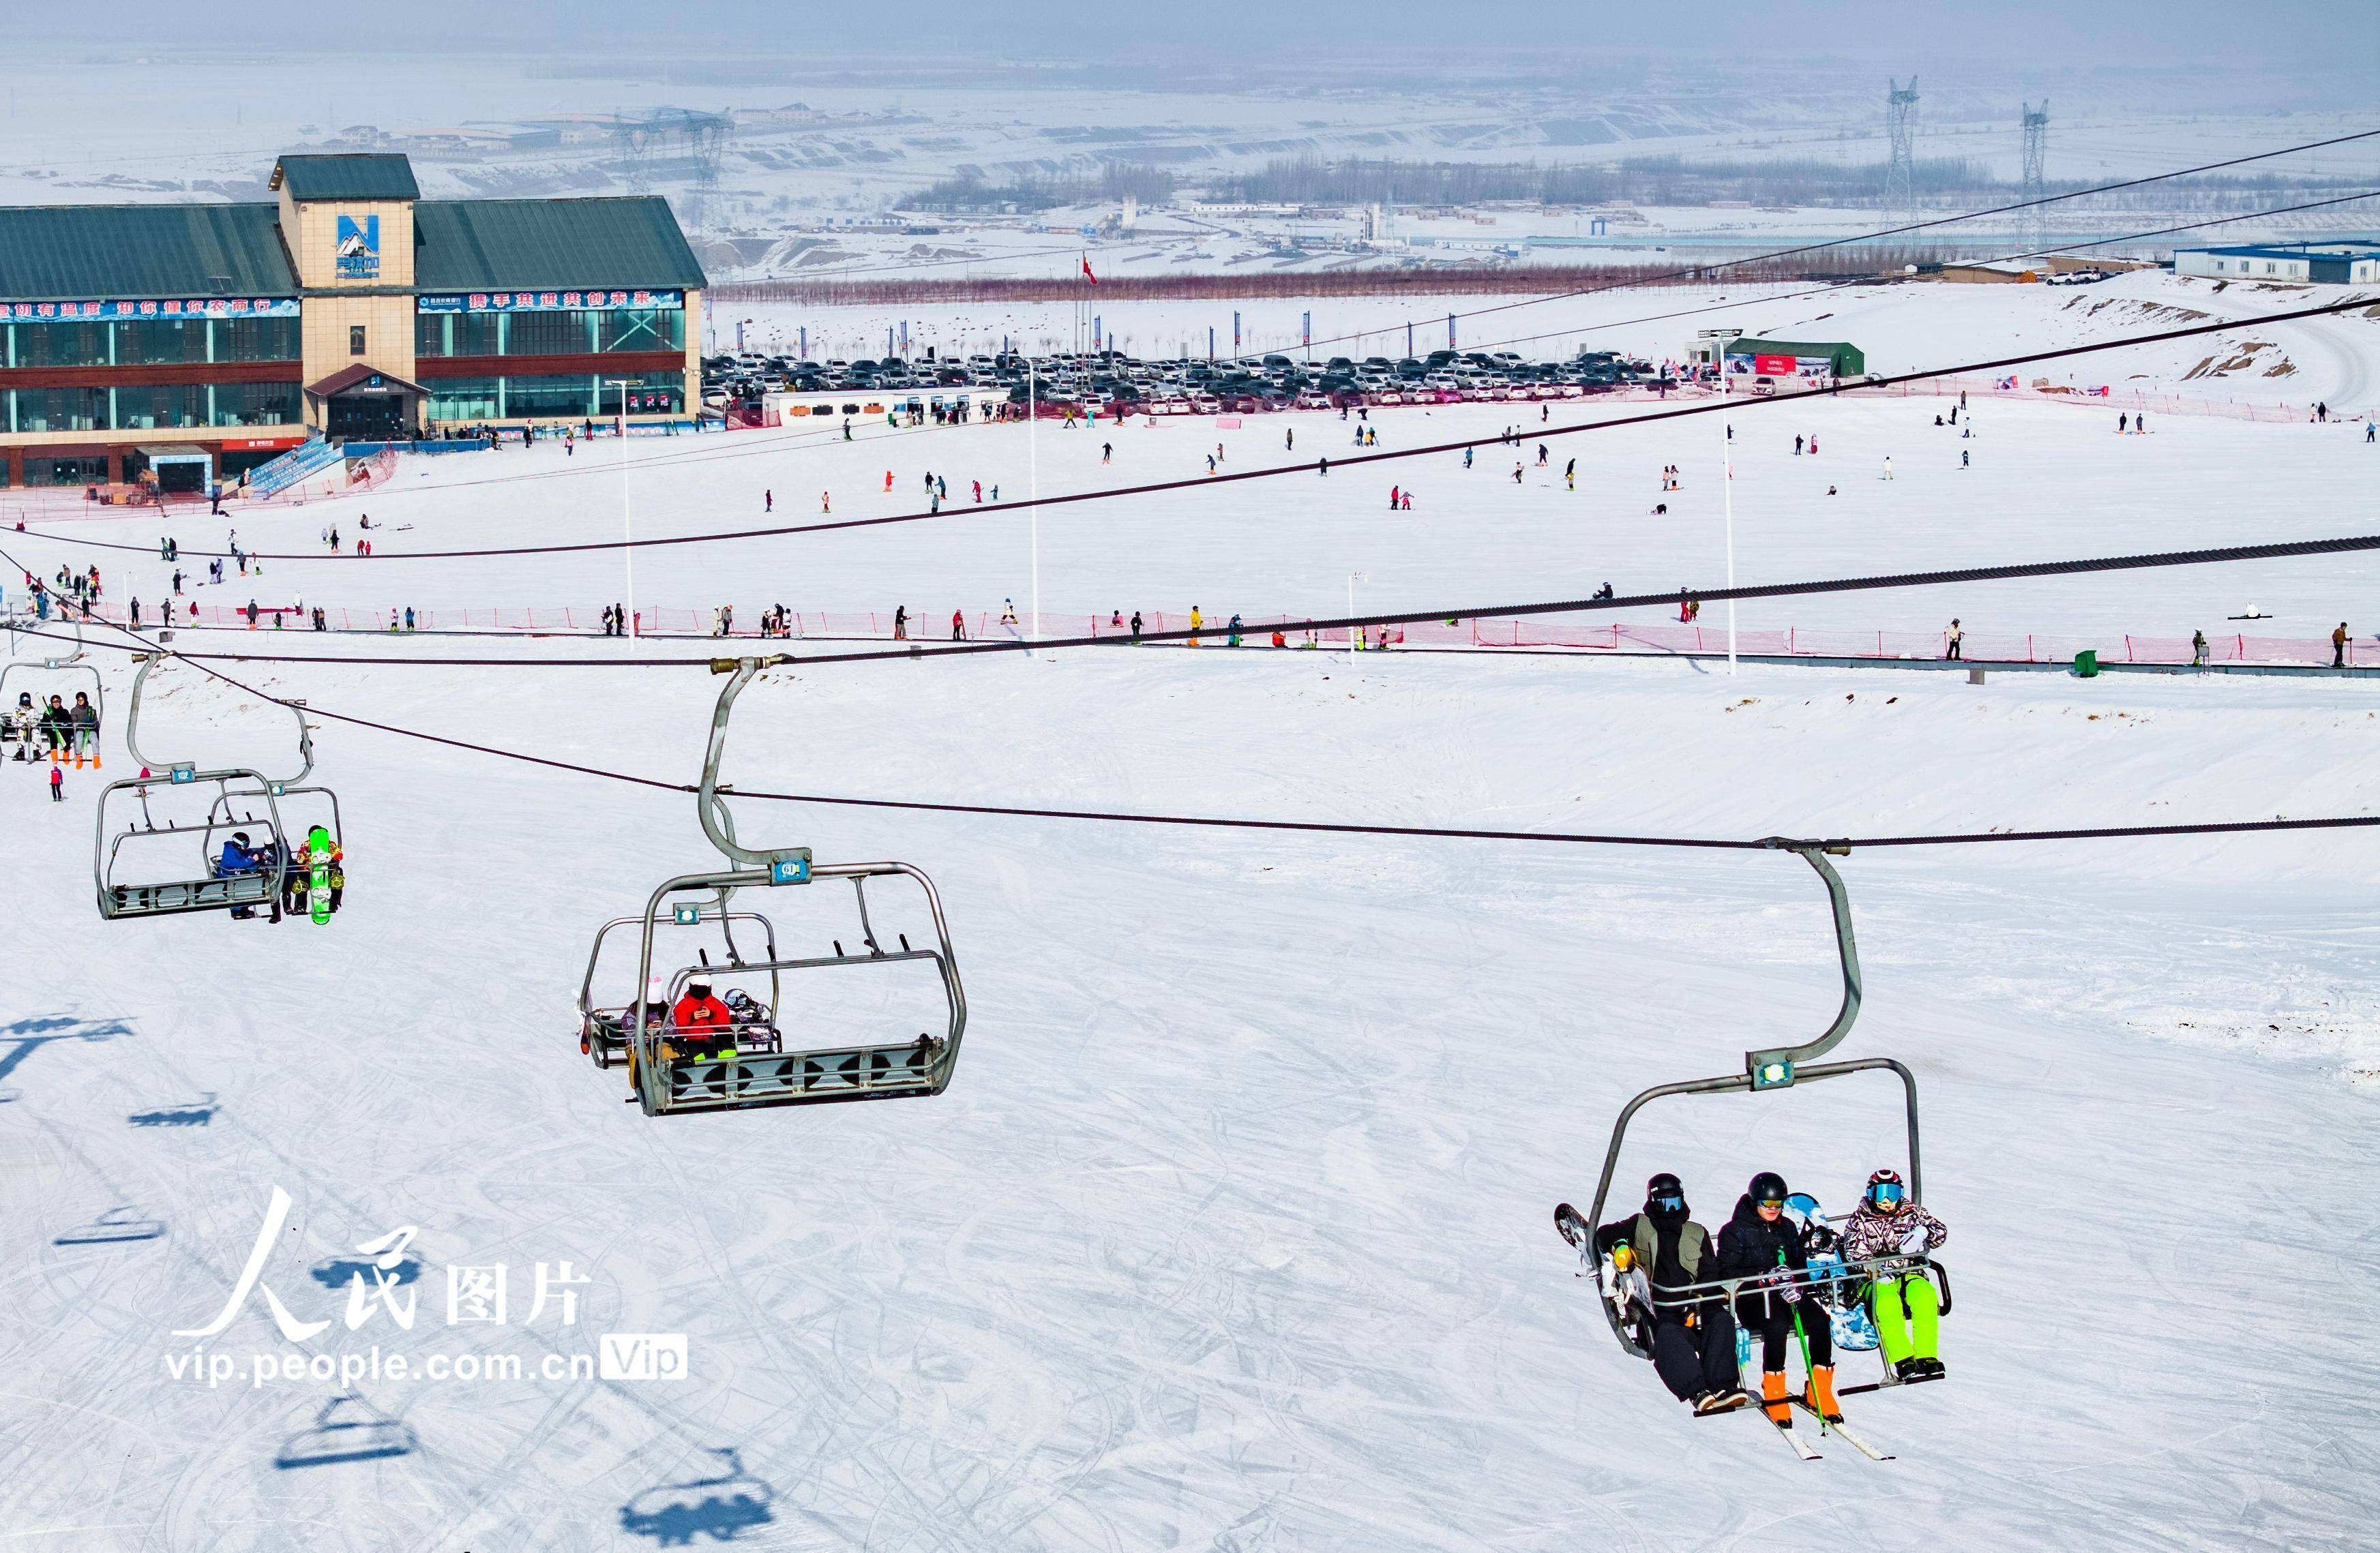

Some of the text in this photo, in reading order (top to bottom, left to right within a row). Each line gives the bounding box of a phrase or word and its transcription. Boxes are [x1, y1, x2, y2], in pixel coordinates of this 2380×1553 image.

[117, 299, 271, 314] 知你懂你农商行
[468, 291, 651, 308] 携手共进共创未来
